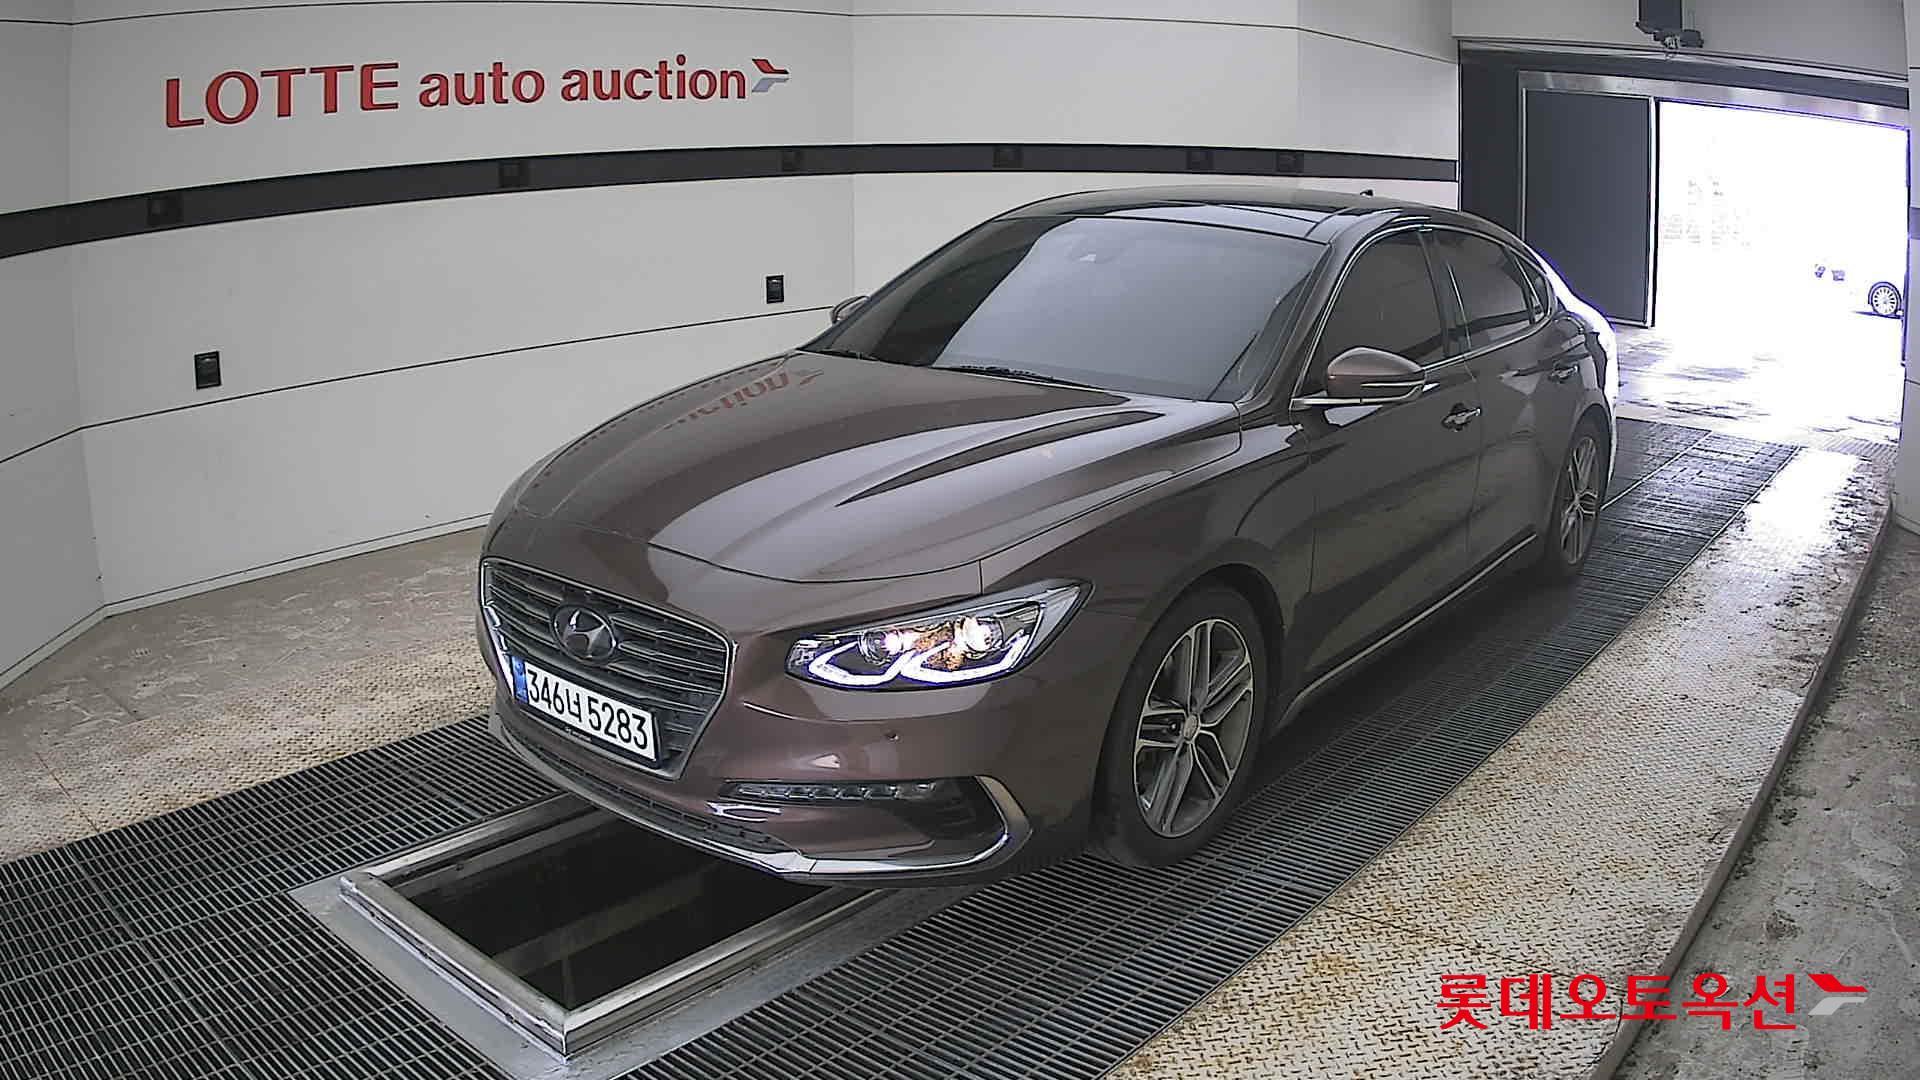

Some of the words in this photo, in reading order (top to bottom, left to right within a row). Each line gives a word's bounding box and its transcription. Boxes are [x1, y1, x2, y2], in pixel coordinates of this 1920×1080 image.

[165, 63, 399, 128] LOTTE
[418, 62, 545, 107] auto
[561, 54, 746, 101] auction
[528, 669, 582, 722] 346너
[587, 696, 647, 750] 5283
